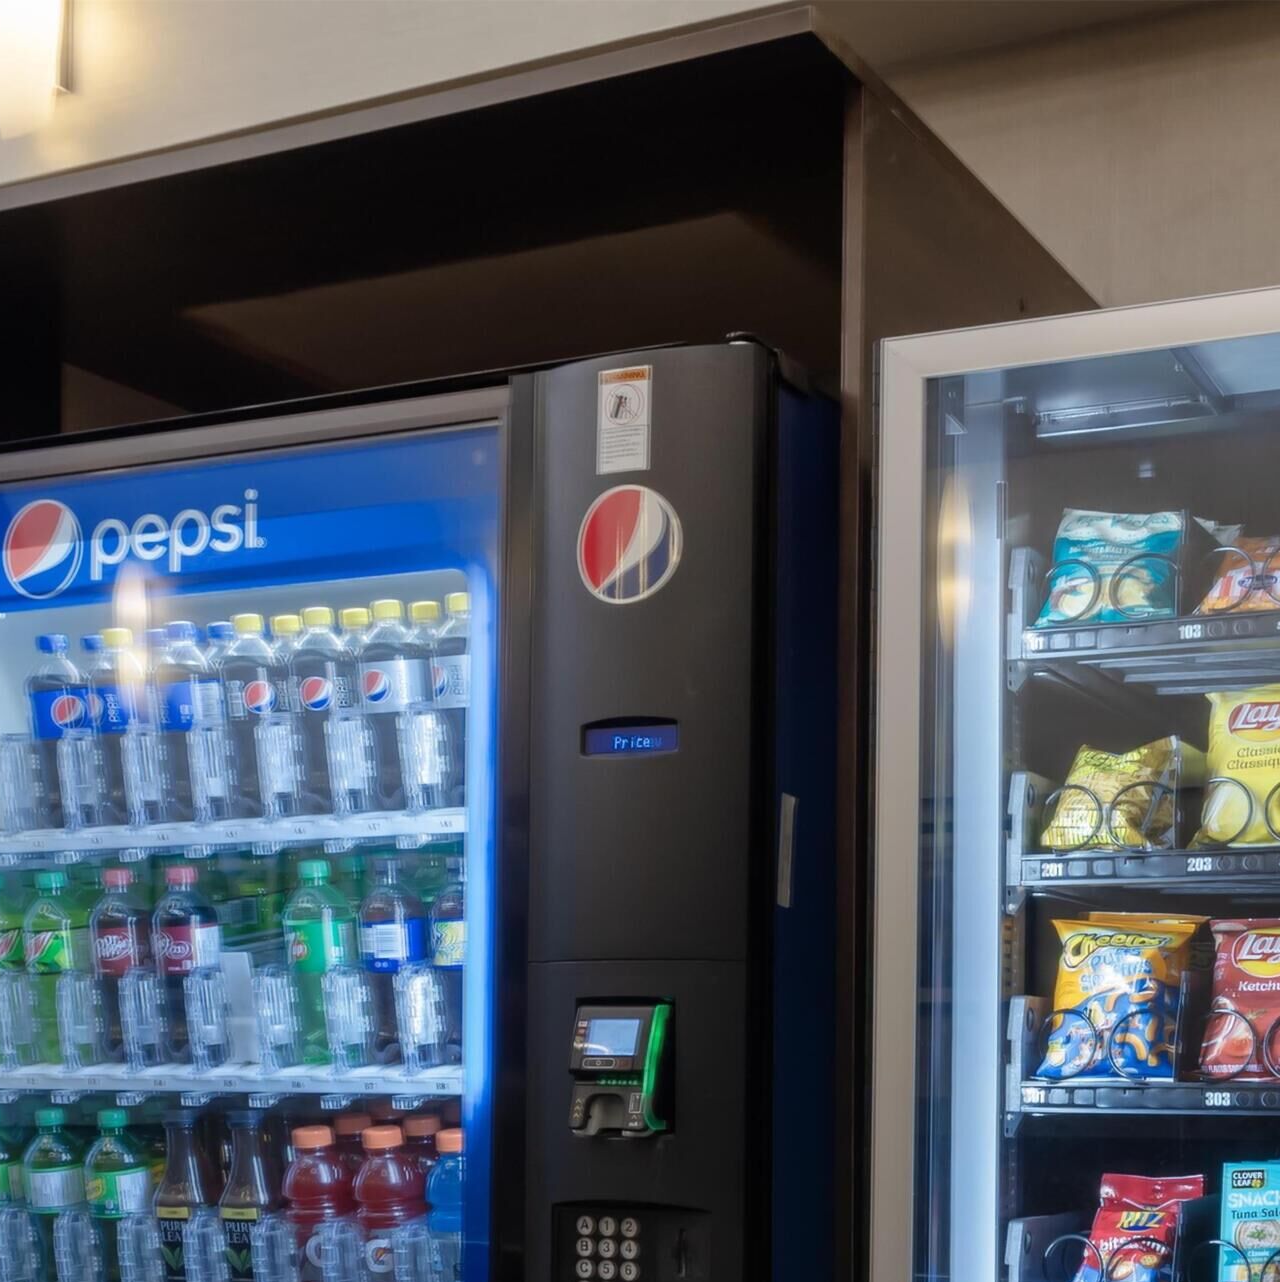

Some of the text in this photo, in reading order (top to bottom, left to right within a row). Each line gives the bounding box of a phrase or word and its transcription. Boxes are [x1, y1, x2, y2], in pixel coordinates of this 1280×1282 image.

[90, 489, 263, 582] pepsi
[1179, 625, 1201, 639] 103
[614, 736, 651, 750] Price
[1042, 863, 1063, 877] 201
[1187, 858, 1212, 871] 203
[1206, 1092, 1230, 1106] 303
[1233, 1171, 1264, 1180] CLOVER
[1233, 1179, 1253, 1188] LEAF
[1116, 1210, 1166, 1229] RITZ
[1231, 1209, 1259, 1219] Tuna
[581, 1219, 633, 1232] A 1 2
[161, 1230, 183, 1243] LEA
[226, 1232, 250, 1244] LEA
[580, 1240, 633, 1254] B 3 4
[580, 1262, 632, 1276] C 5 6
